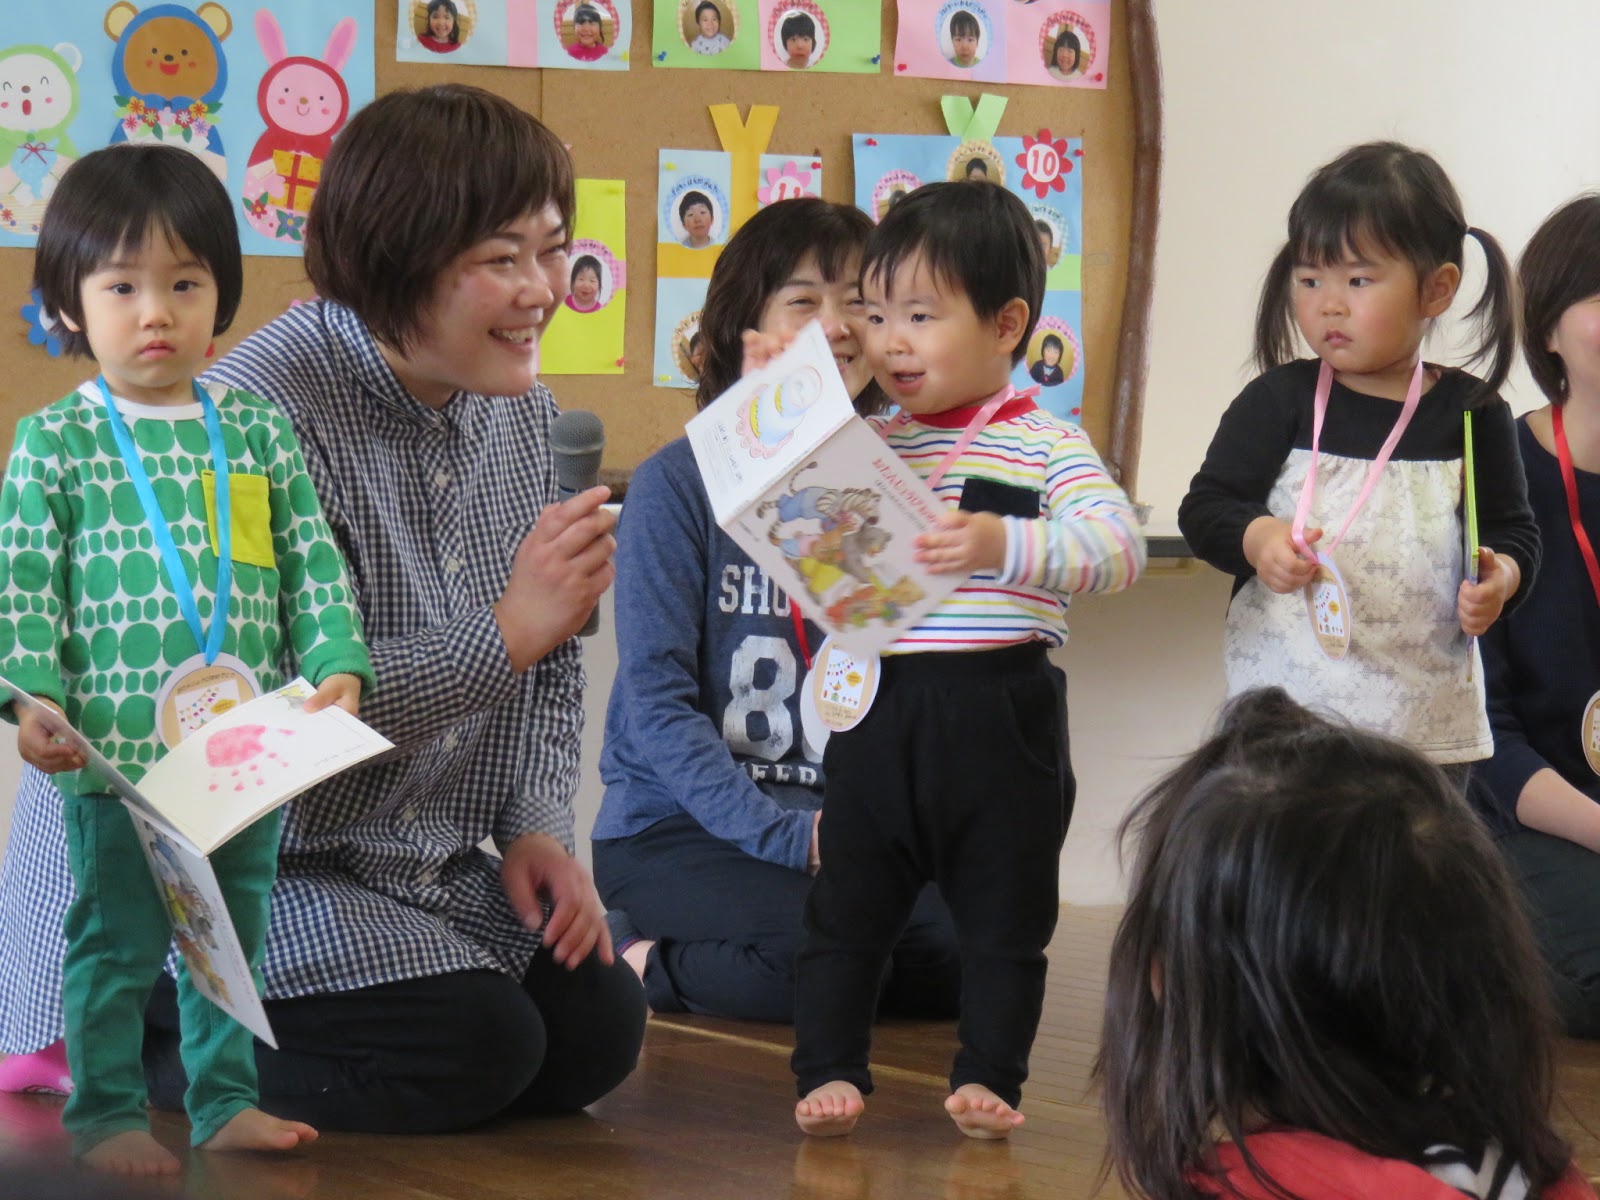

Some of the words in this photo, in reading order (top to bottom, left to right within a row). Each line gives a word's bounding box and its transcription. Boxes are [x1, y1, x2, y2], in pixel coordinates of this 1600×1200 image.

[1031, 150, 1057, 175] 10
[718, 564, 806, 618] SHO
[722, 635, 824, 763] 8
